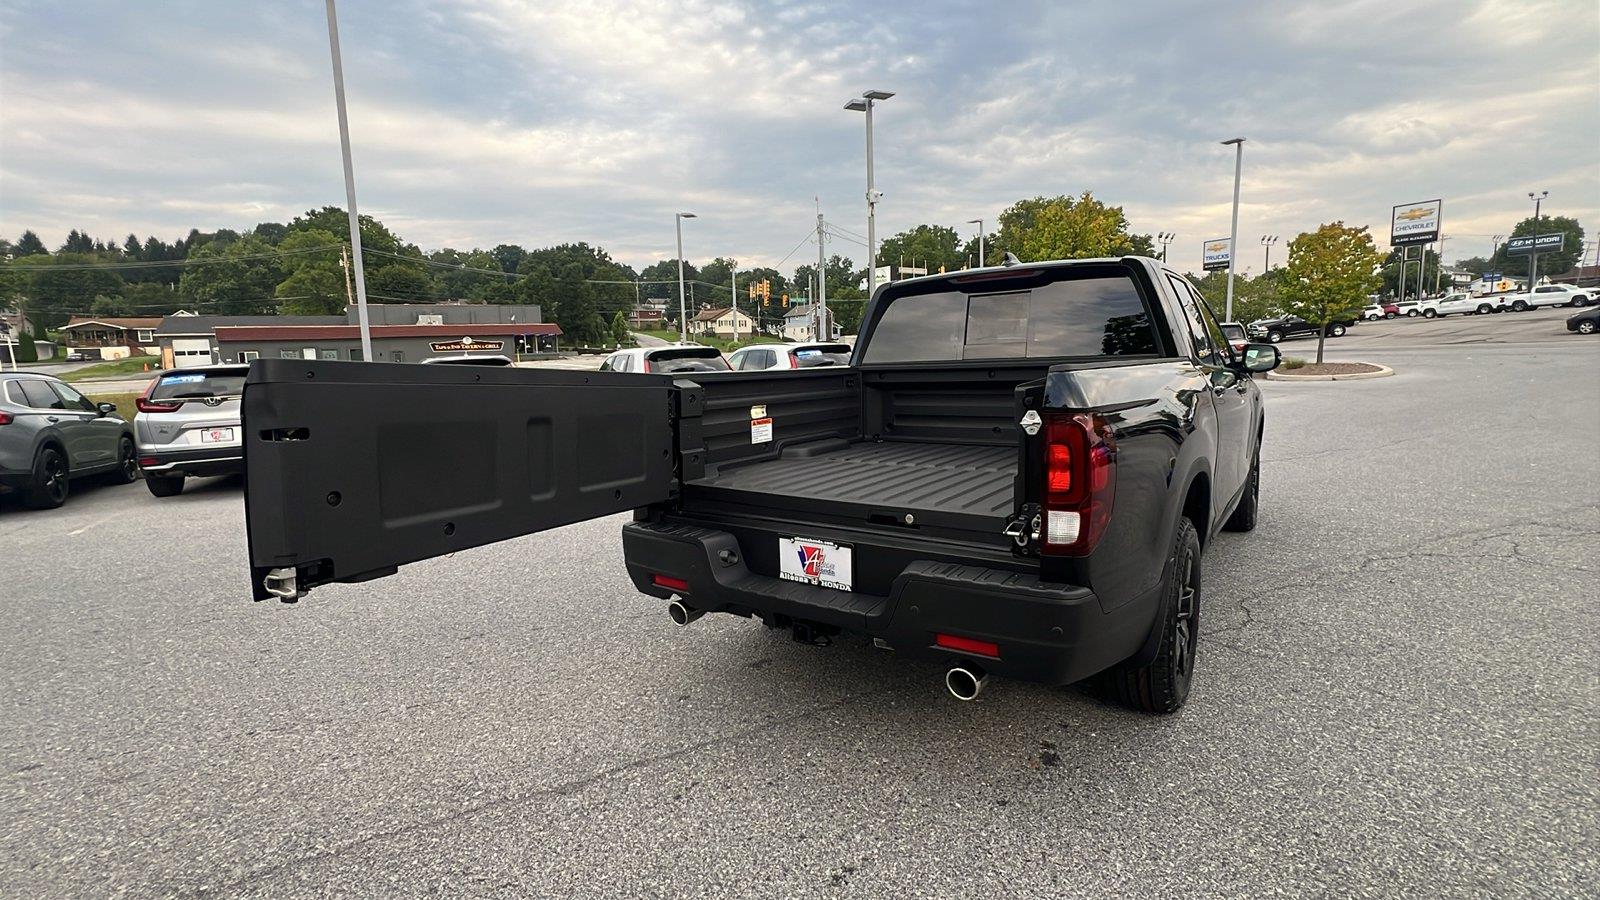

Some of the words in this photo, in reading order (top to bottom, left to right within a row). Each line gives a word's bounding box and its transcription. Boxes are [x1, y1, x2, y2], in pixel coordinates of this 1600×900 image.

[1395, 222, 1434, 231] CHEVROLET
[1206, 253, 1230, 261] TRUCKS
[779, 571, 809, 584] Altoona
[821, 580, 852, 592] HONDA
